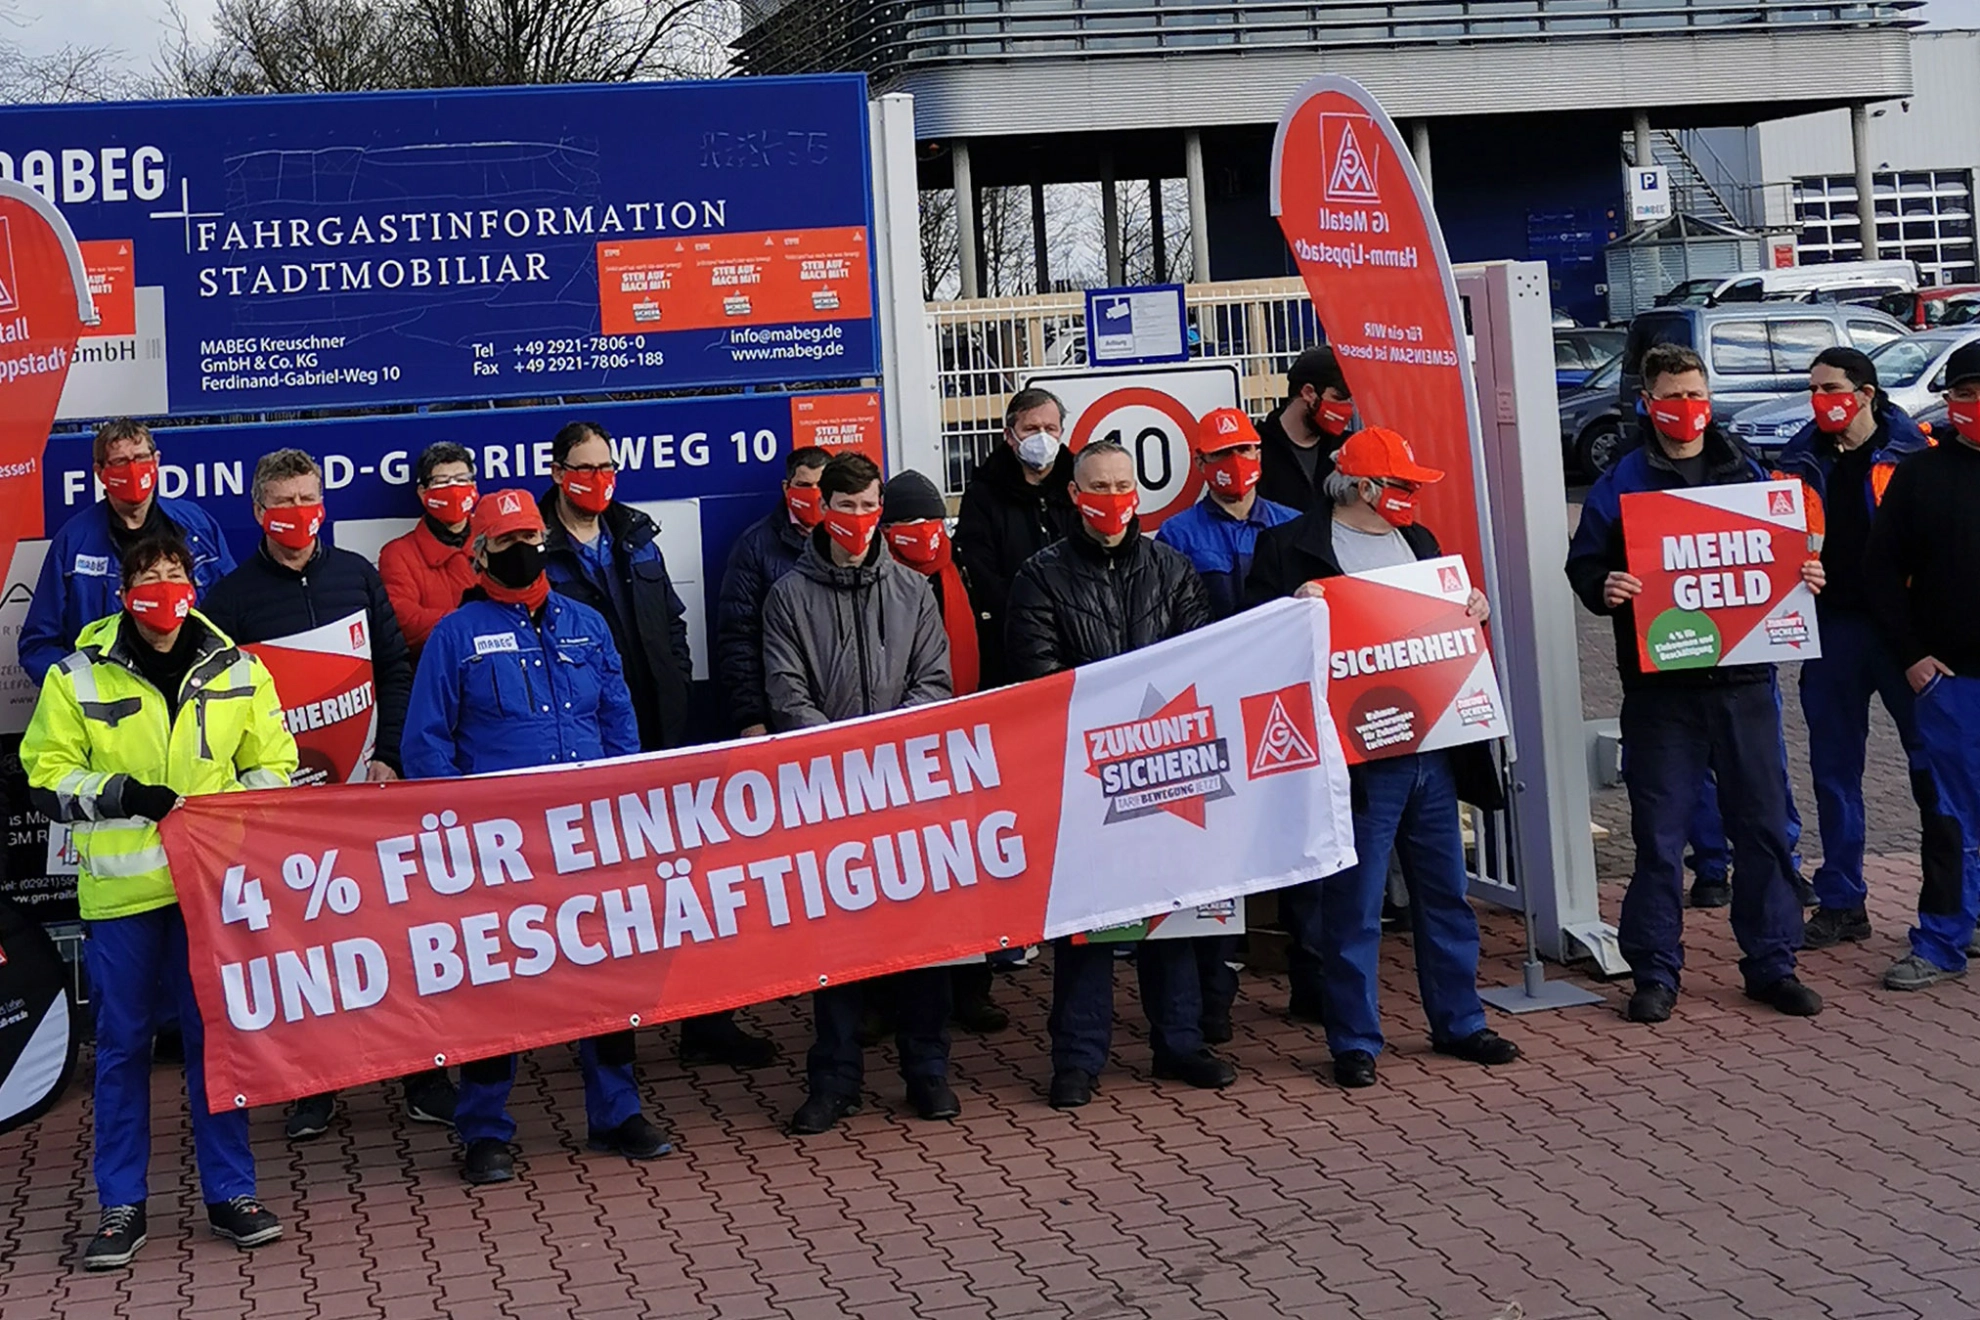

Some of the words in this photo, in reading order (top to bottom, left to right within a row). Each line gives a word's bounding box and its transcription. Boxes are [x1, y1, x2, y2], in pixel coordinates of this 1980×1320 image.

[1643, 173, 1655, 189] P
[197, 199, 727, 251] FAHRGASTINFORMATION
[199, 252, 550, 298] STADTMOBILIAR
[0, 316, 30, 343] tall
[200, 338, 257, 355] MABEG
[260, 335, 346, 351] Kreuschner
[471, 342, 494, 358] Tel
[513, 340, 544, 356] +49
[547, 335, 646, 354] 2921-7806-0
[730, 323, 843, 344] info@mabeg.de
[0, 346, 67, 383] ppstadt
[200, 357, 250, 373] GmbH
[253, 357, 266, 370] &
[268, 355, 293, 369] Co.
[295, 353, 318, 368] KG
[473, 361, 500, 376] Fax
[514, 358, 545, 373] +49
[548, 351, 664, 372] 2921-7806-188
[731, 341, 844, 361] www.mabeg.de
[201, 367, 378, 391] Ferdinand-Gabriel-Weg
[381, 365, 401, 381] 10
[730, 429, 778, 464] 10
[0, 457, 36, 478] esser!
[1662, 529, 1775, 571] MEHR
[1673, 569, 1772, 611] GELD
[1330, 627, 1478, 679] SICHERHEIT
[282, 681, 372, 735] HERHEIT
[1089, 710, 1210, 761] ZUKUNFT
[1102, 743, 1228, 793] SICHERN.
[221, 864, 272, 931] 4
[282, 849, 361, 921] %
[375, 809, 534, 904] FÜR
[545, 723, 1001, 875] EINKOMMEN
[220, 936, 389, 1031] UND
[408, 810, 1028, 997] BESCHÄFTIGUNG
